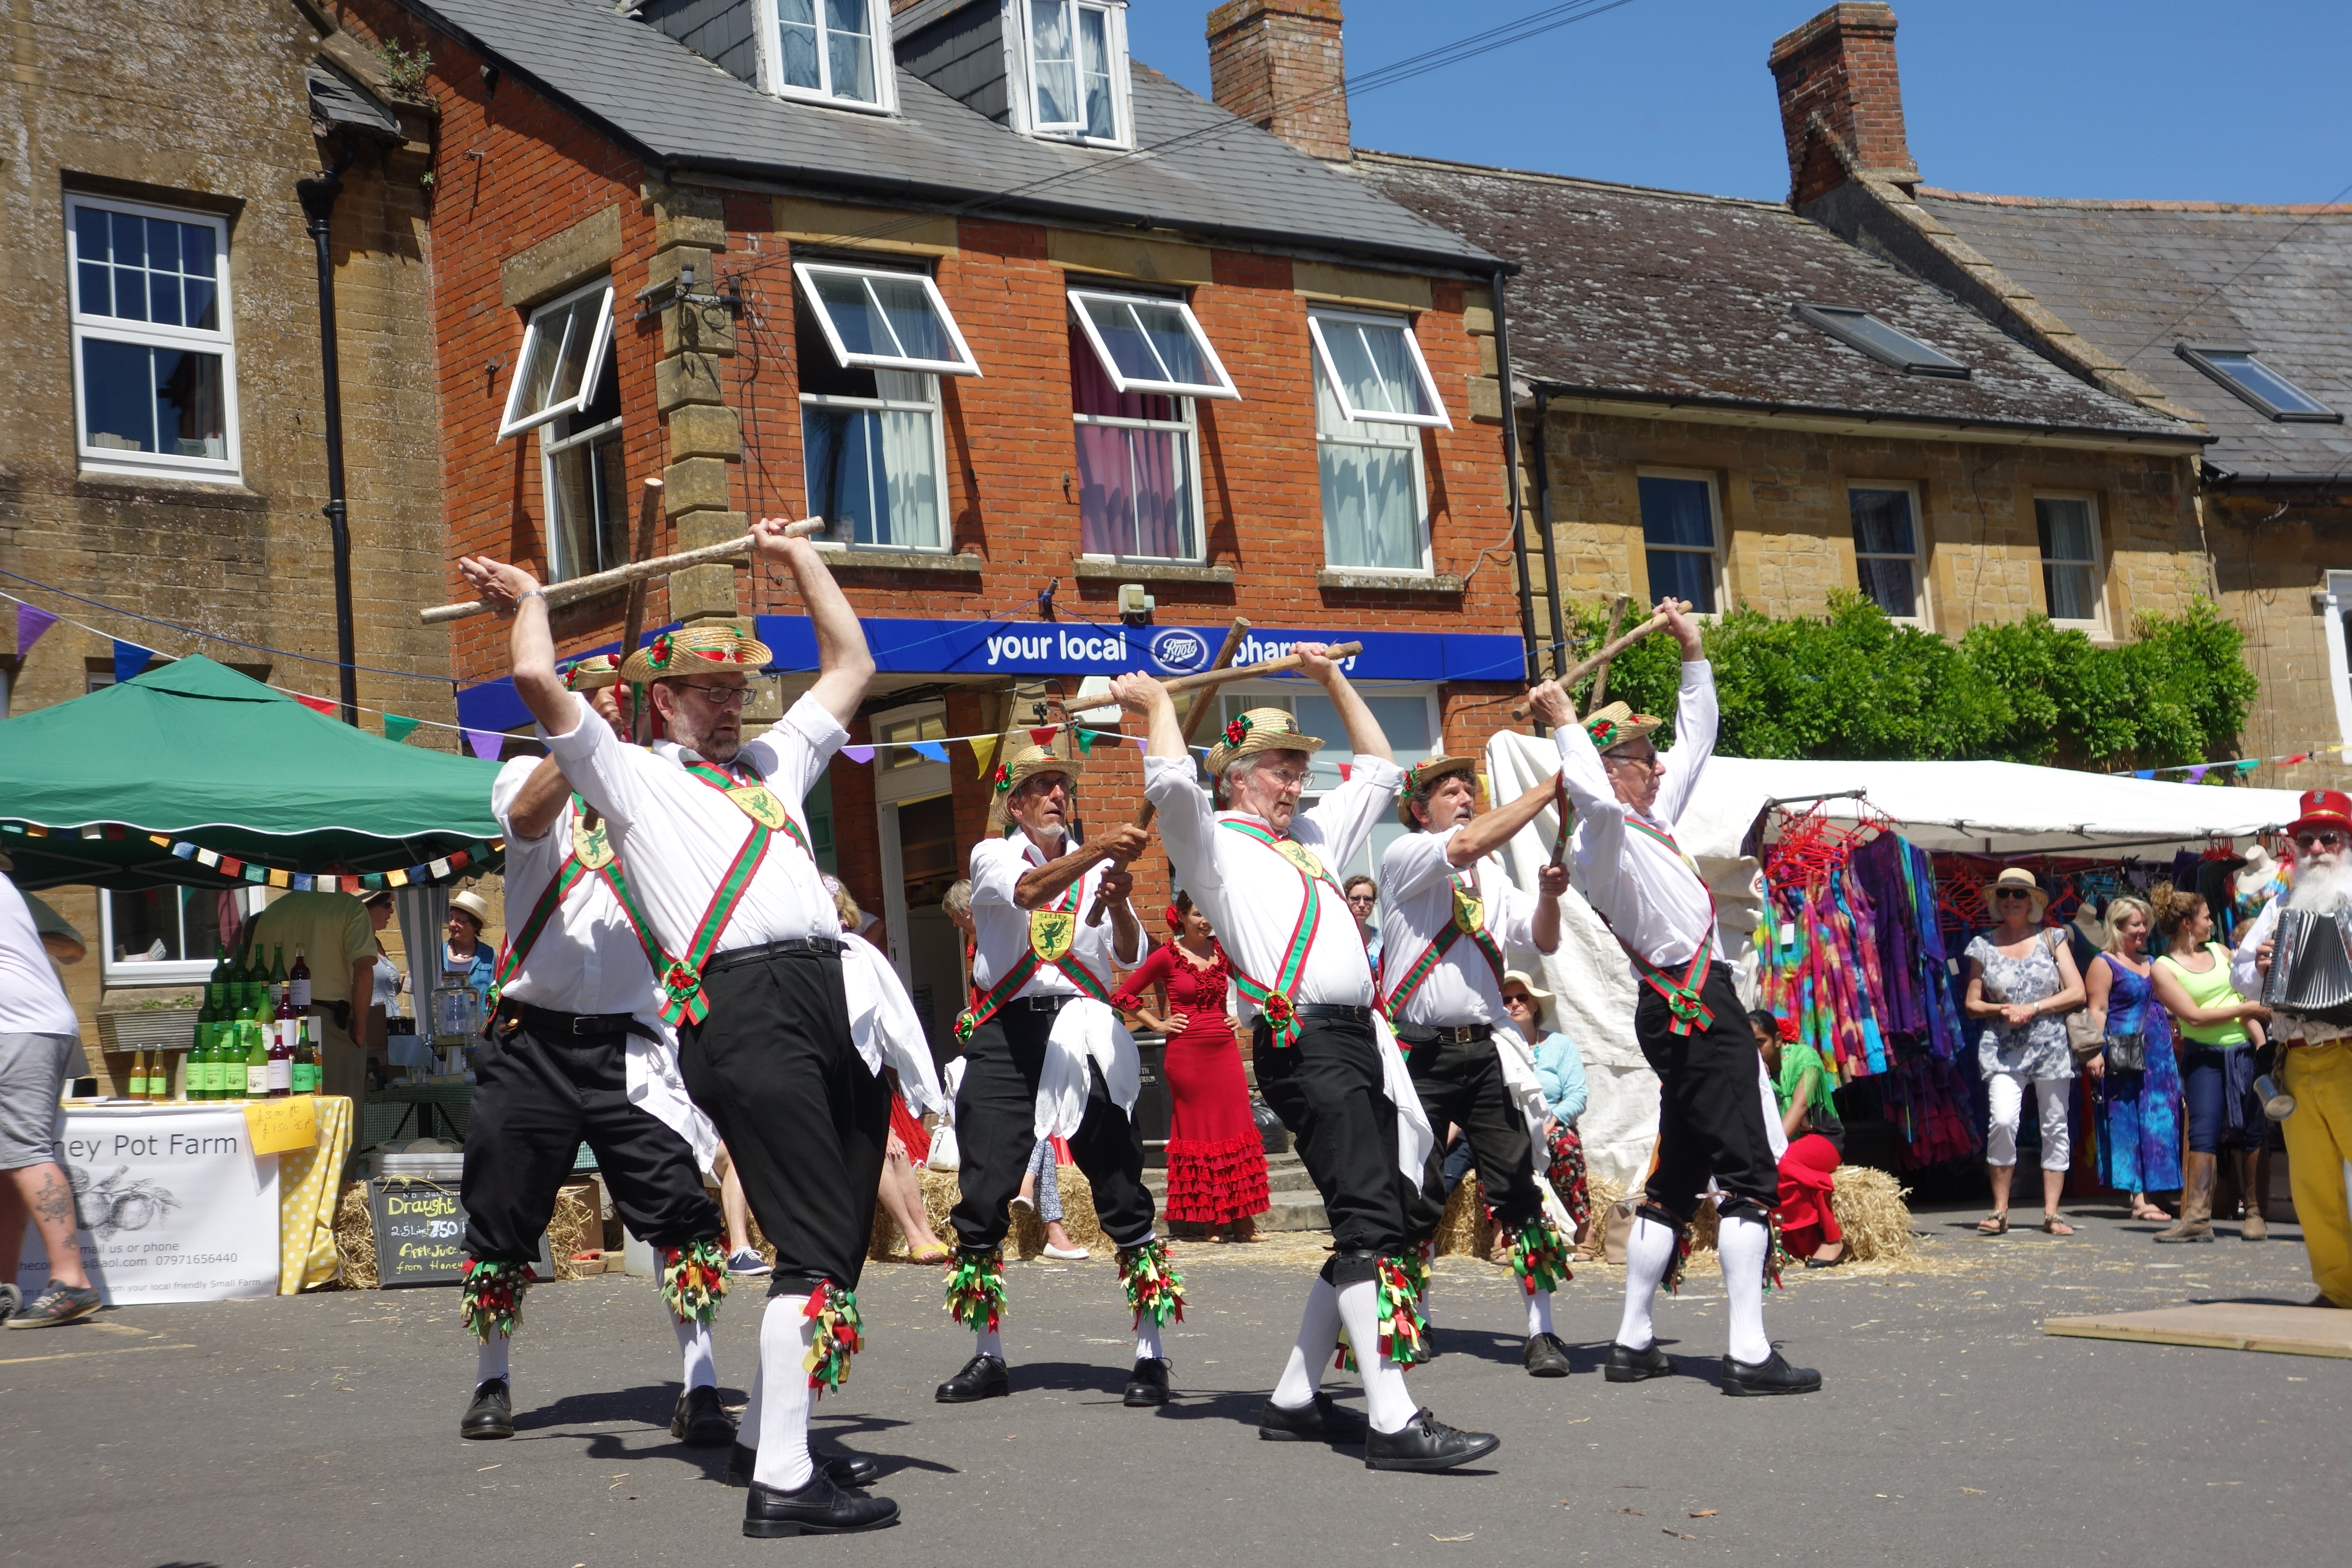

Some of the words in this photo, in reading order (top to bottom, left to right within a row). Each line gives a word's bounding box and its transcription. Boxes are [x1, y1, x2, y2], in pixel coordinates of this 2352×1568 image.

[987, 635, 1053, 665] your
[1060, 631, 1127, 661] local
[1160, 637, 1199, 663] Boots
[1231, 635, 1356, 671] phary
[52, 1139, 102, 1162] ney
[114, 1134, 158, 1156] Pot
[170, 1133, 238, 1155] Farm
[388, 1197, 456, 1217] Draught
[80, 1244, 104, 1254] mail
[110, 1245, 122, 1253] us
[127, 1244, 140, 1252] or
[144, 1242, 179, 1255] phone
[399, 1243, 432, 1259] Apple
[431, 1244, 458, 1257] Juice
[156, 1253, 238, 1266] 07971656440
[396, 1261, 422, 1275] from
[430, 1259, 463, 1271] Honey
[128, 1283, 147, 1292] your
[151, 1282, 171, 1290] local
[174, 1281, 207, 1290] friendly
[210, 1279, 235, 1288] Small
